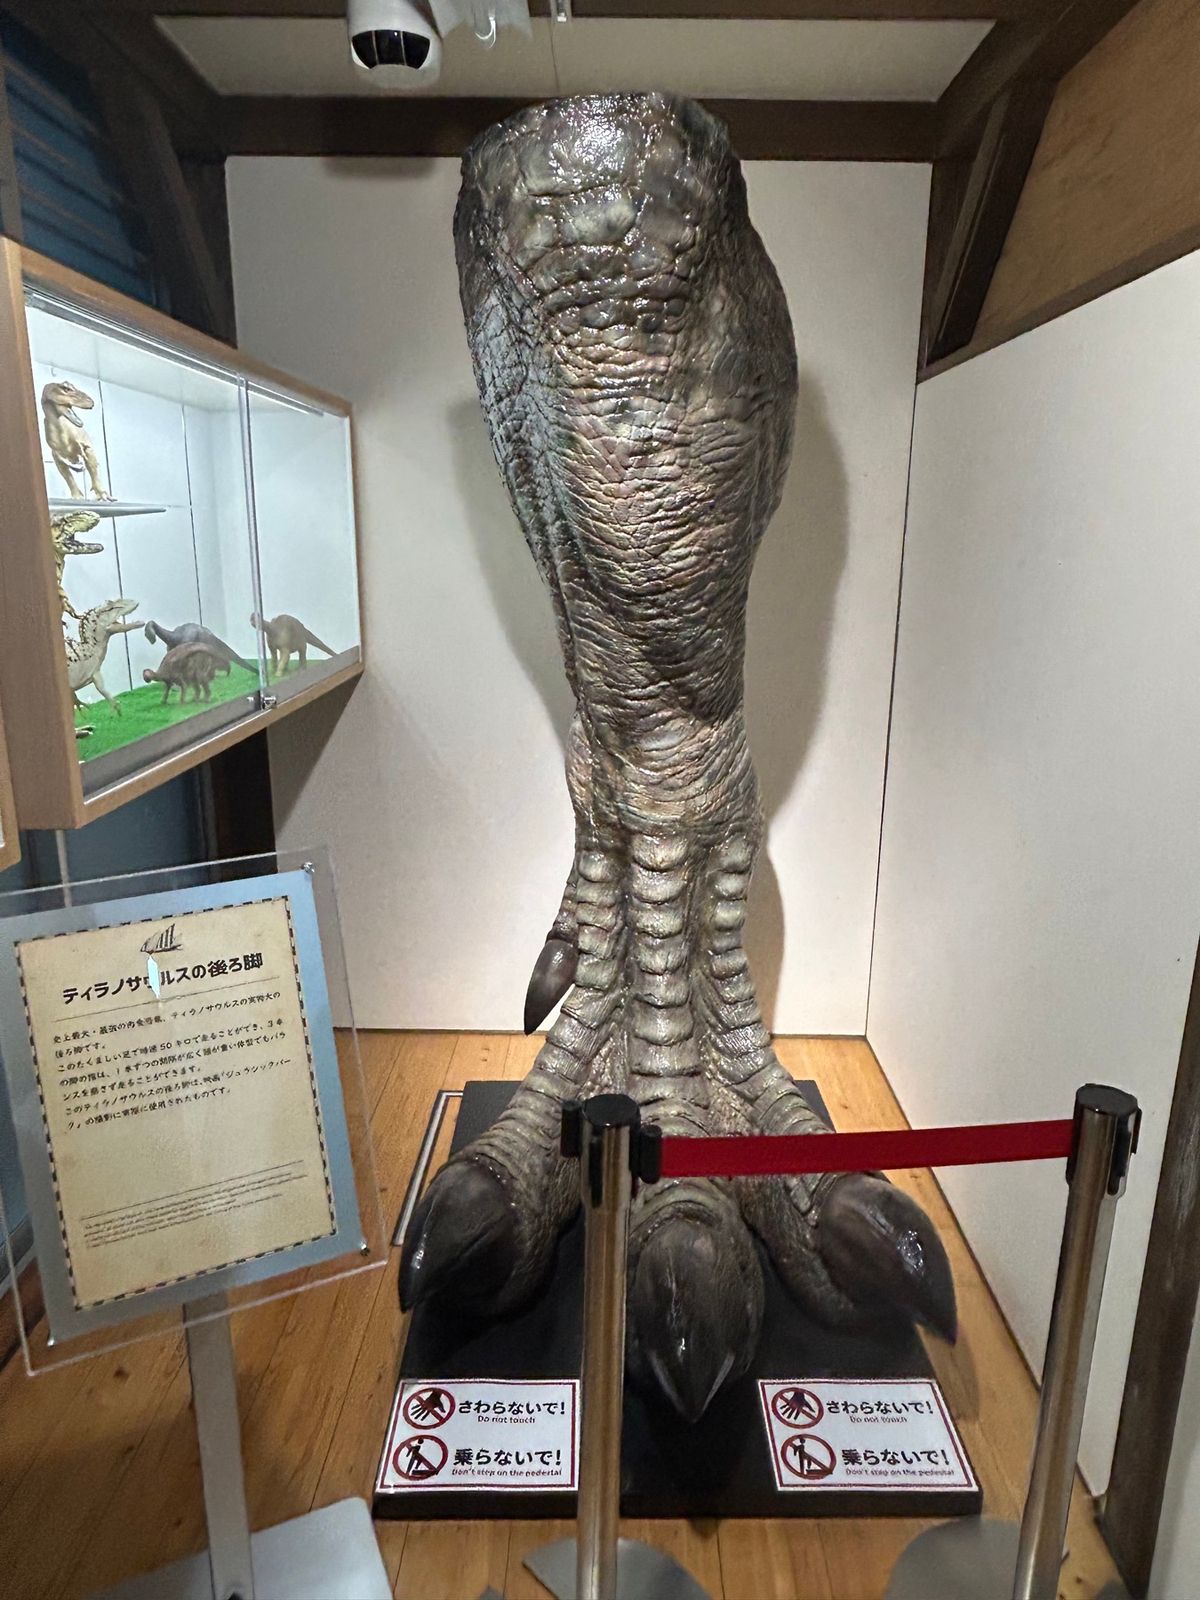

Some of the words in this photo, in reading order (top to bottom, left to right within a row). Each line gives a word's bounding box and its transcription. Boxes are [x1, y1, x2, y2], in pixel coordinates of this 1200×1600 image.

[459, 1400, 565, 1415] さわらないで!
[826, 1400, 934, 1415] さわらないで!
[477, 1415, 488, 1423] Do
[492, 1415, 507, 1423] not
[510, 1415, 535, 1424] touch
[849, 1415, 862, 1423] Do
[864, 1415, 879, 1423] not
[881, 1415, 908, 1423] touch
[453, 1448, 561, 1466] 乗らないで!
[477, 1467, 495, 1478] step
[510, 1467, 524, 1476] the
[903, 1468, 917, 1476] the
